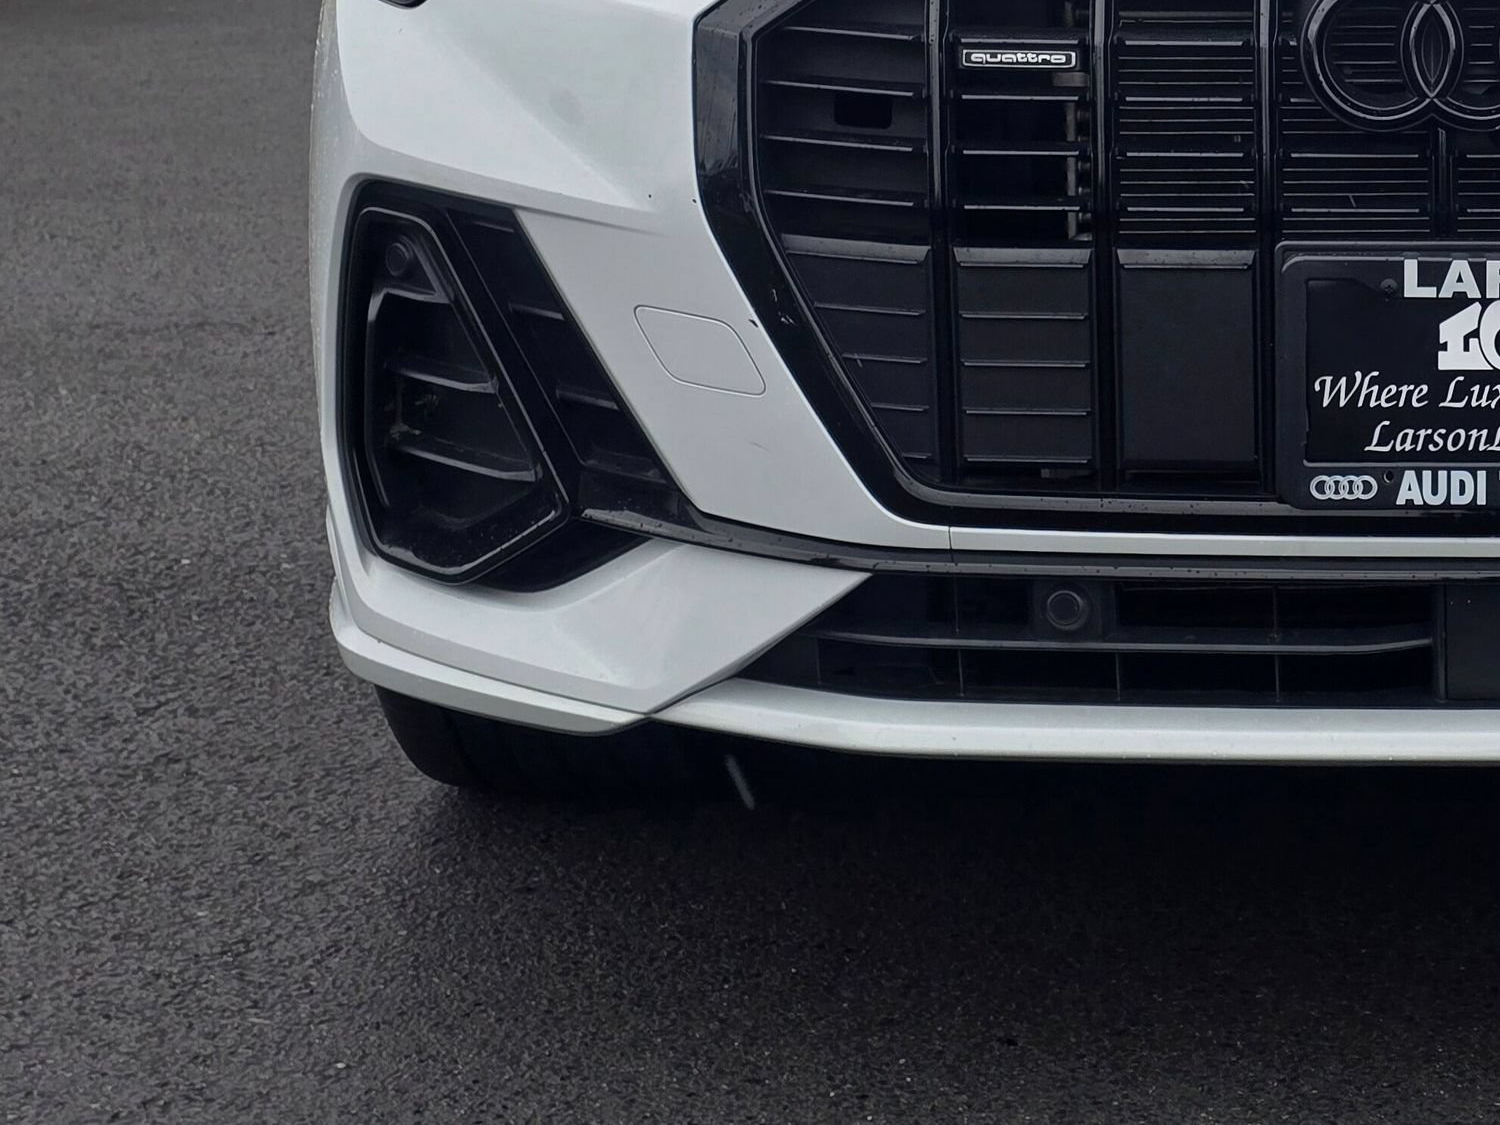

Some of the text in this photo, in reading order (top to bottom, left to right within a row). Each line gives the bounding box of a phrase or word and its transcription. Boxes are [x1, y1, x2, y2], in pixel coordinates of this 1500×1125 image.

[970, 52, 1067, 64] quattro
[1314, 370, 1429, 408] Where
[1395, 470, 1487, 506] AUDI
